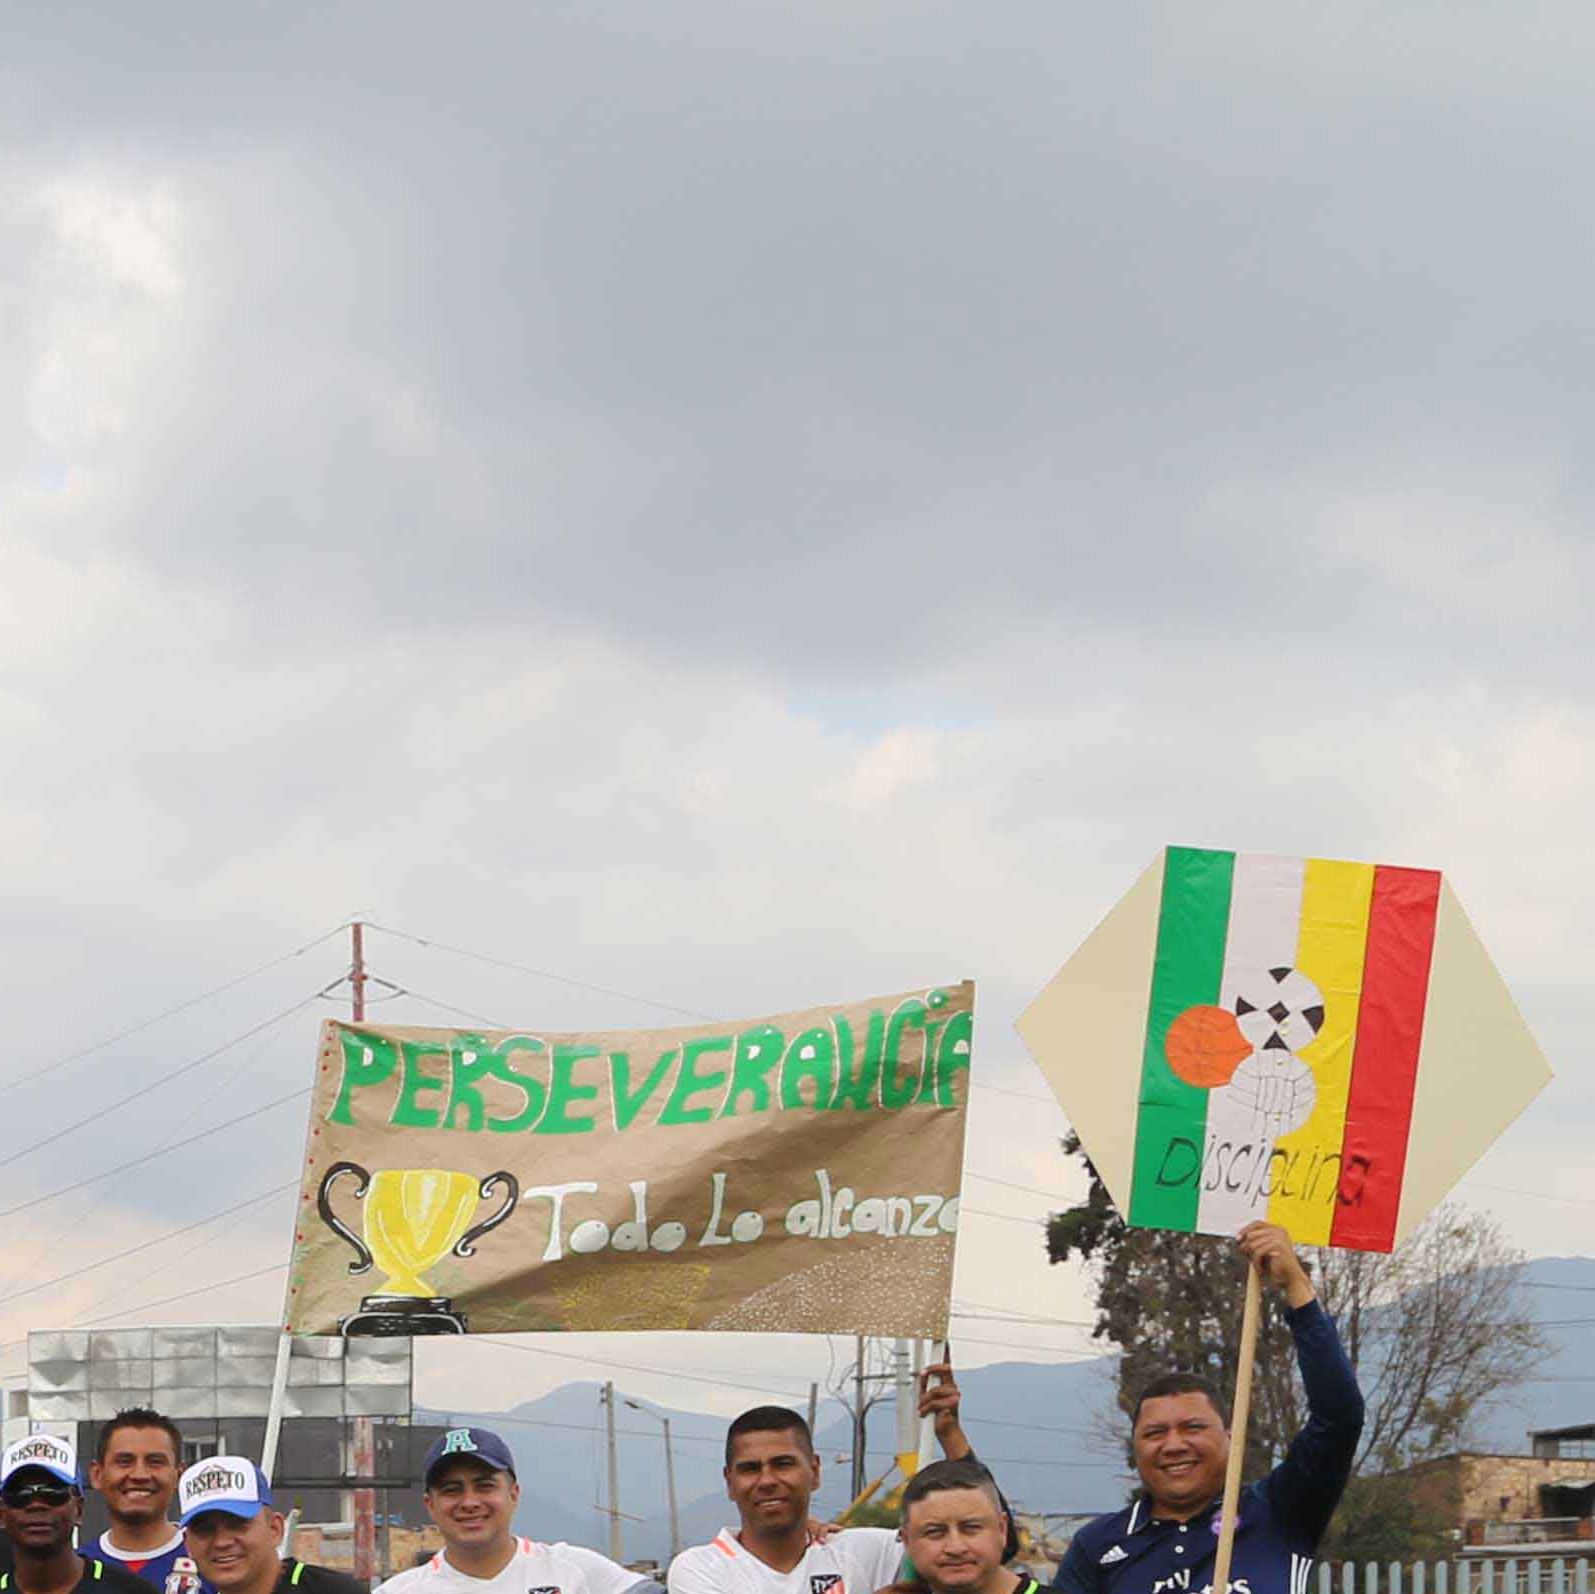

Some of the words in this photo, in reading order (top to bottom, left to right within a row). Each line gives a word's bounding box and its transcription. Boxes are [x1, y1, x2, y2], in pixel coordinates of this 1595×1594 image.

[522, 1180, 685, 1262] Todo
[10, 1442, 68, 1465] RESPETO
[441, 1429, 478, 1456] A
[185, 1469, 245, 1500] RESPETO
